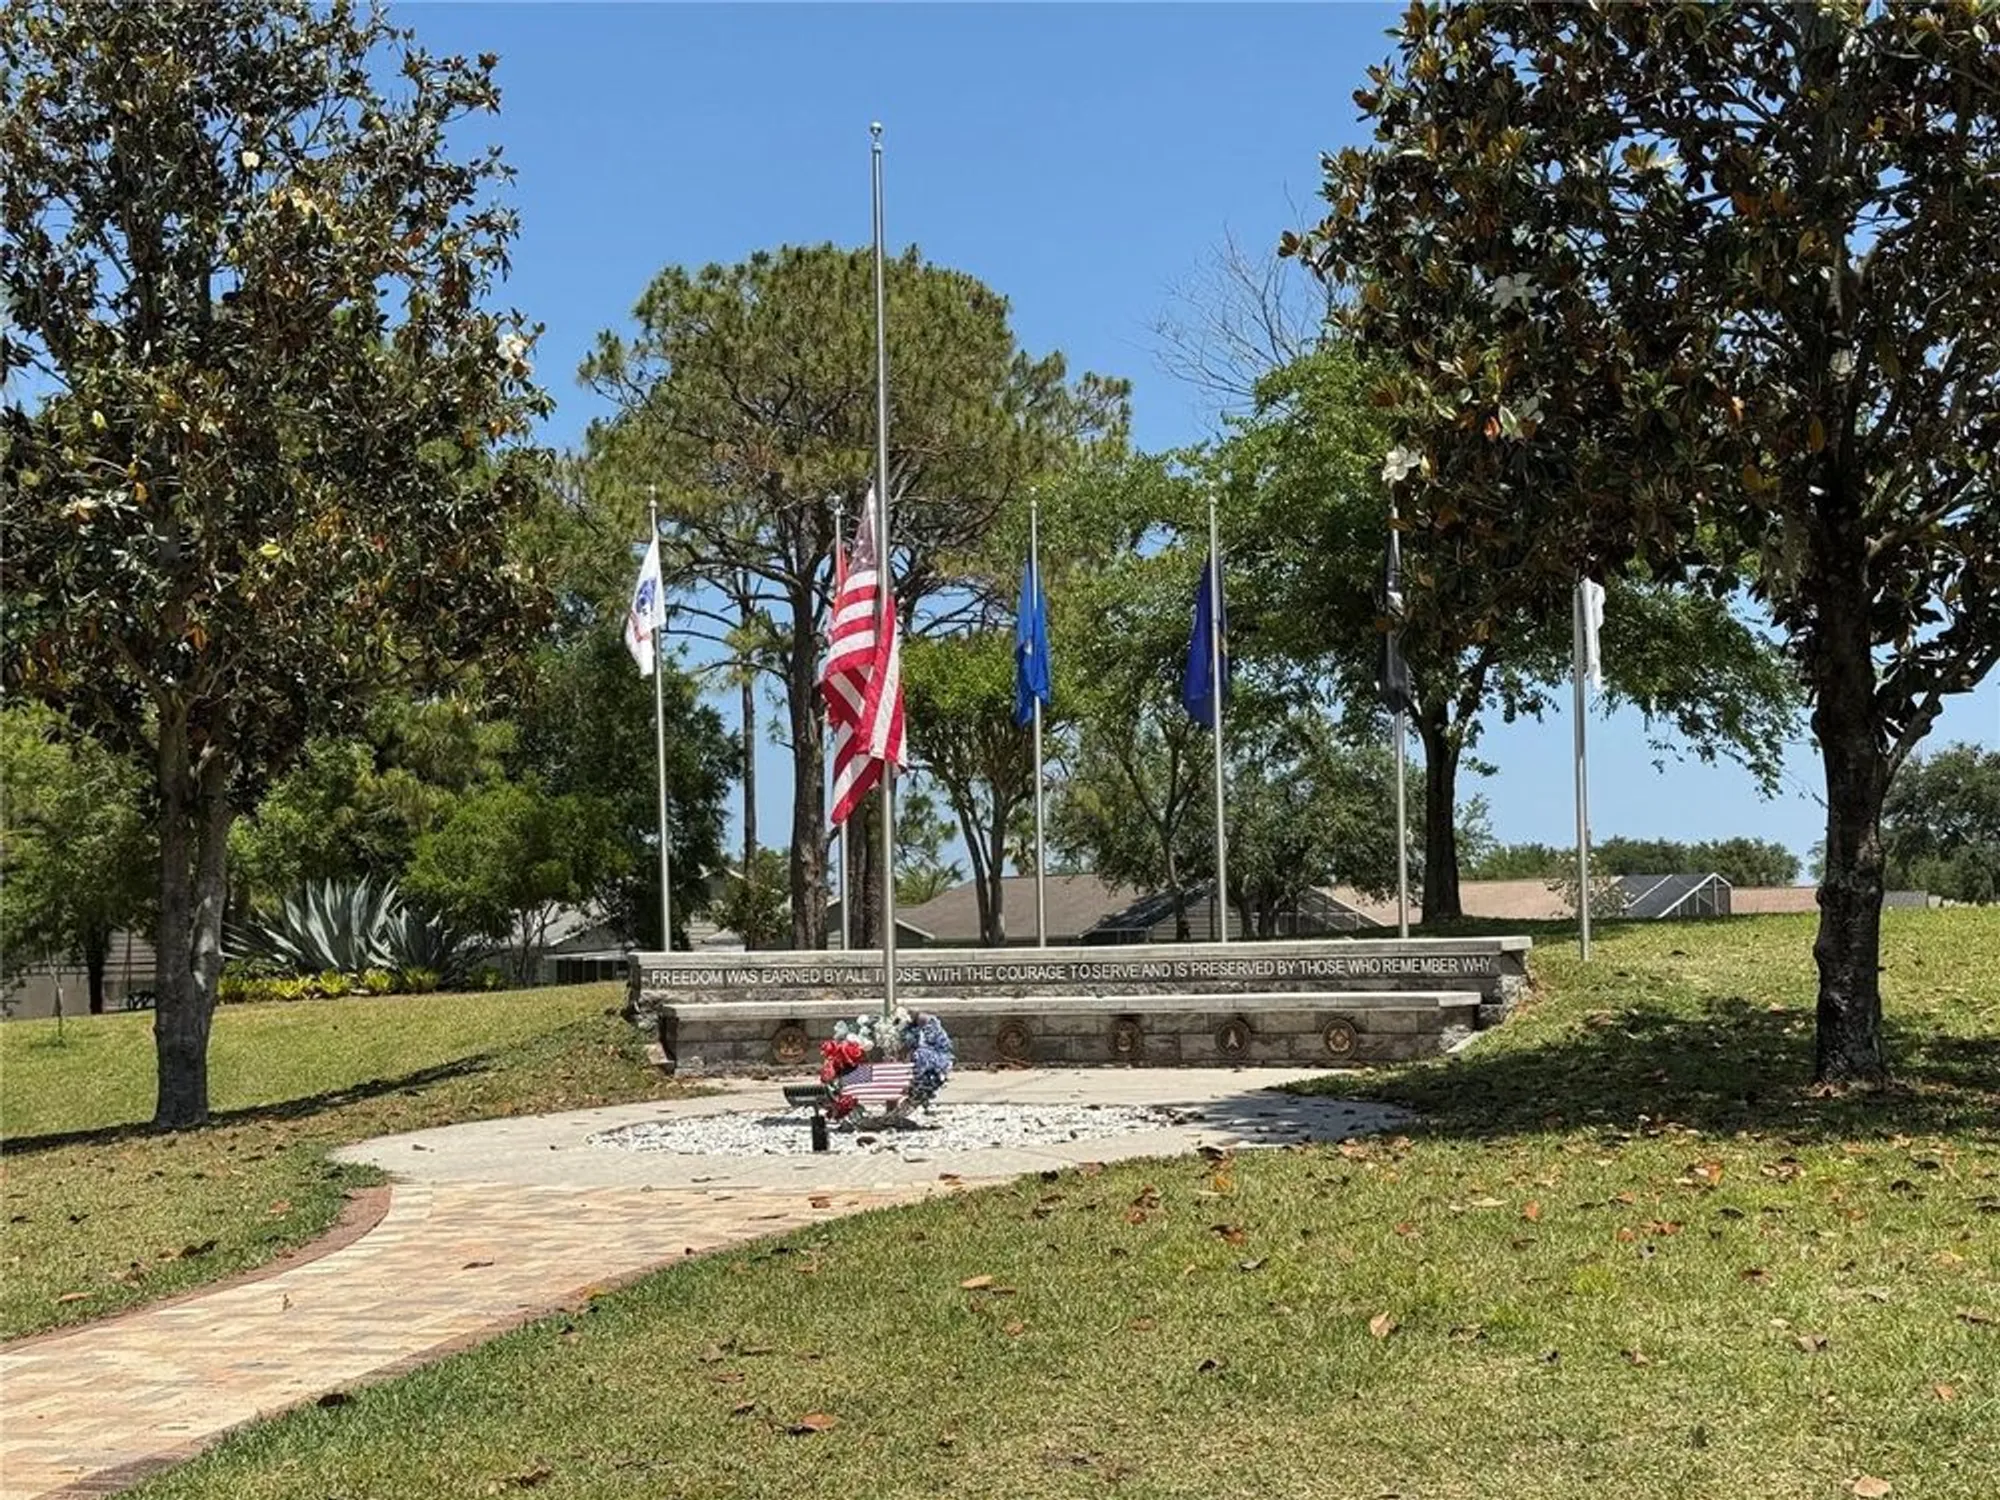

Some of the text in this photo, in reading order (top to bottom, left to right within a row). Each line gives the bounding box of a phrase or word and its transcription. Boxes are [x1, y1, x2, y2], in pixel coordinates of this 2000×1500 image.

[652, 969, 724, 985] FREEDOM
[726, 969, 758, 984] WAS
[762, 968, 820, 983] EARNED
[823, 968, 843, 983] BY
[844, 968, 871, 983] ALL
[926, 967, 961, 981] WITH
[967, 966, 993, 980] THE
[996, 965, 1066, 980] COURAGE
[1069, 964, 1091, 979] TO
[1092, 964, 1140, 979] SERVE
[1142, 963, 1171, 978] AND
[1174, 962, 1188, 977] IS
[1192, 961, 1275, 976] PRESERVED
[1277, 960, 1295, 975] BY
[1300, 960, 1345, 975] THOSE
[1348, 959, 1381, 974] WHO
[1382, 958, 1459, 973] REMEMBER
[1461, 957, 1491, 973] WHY
